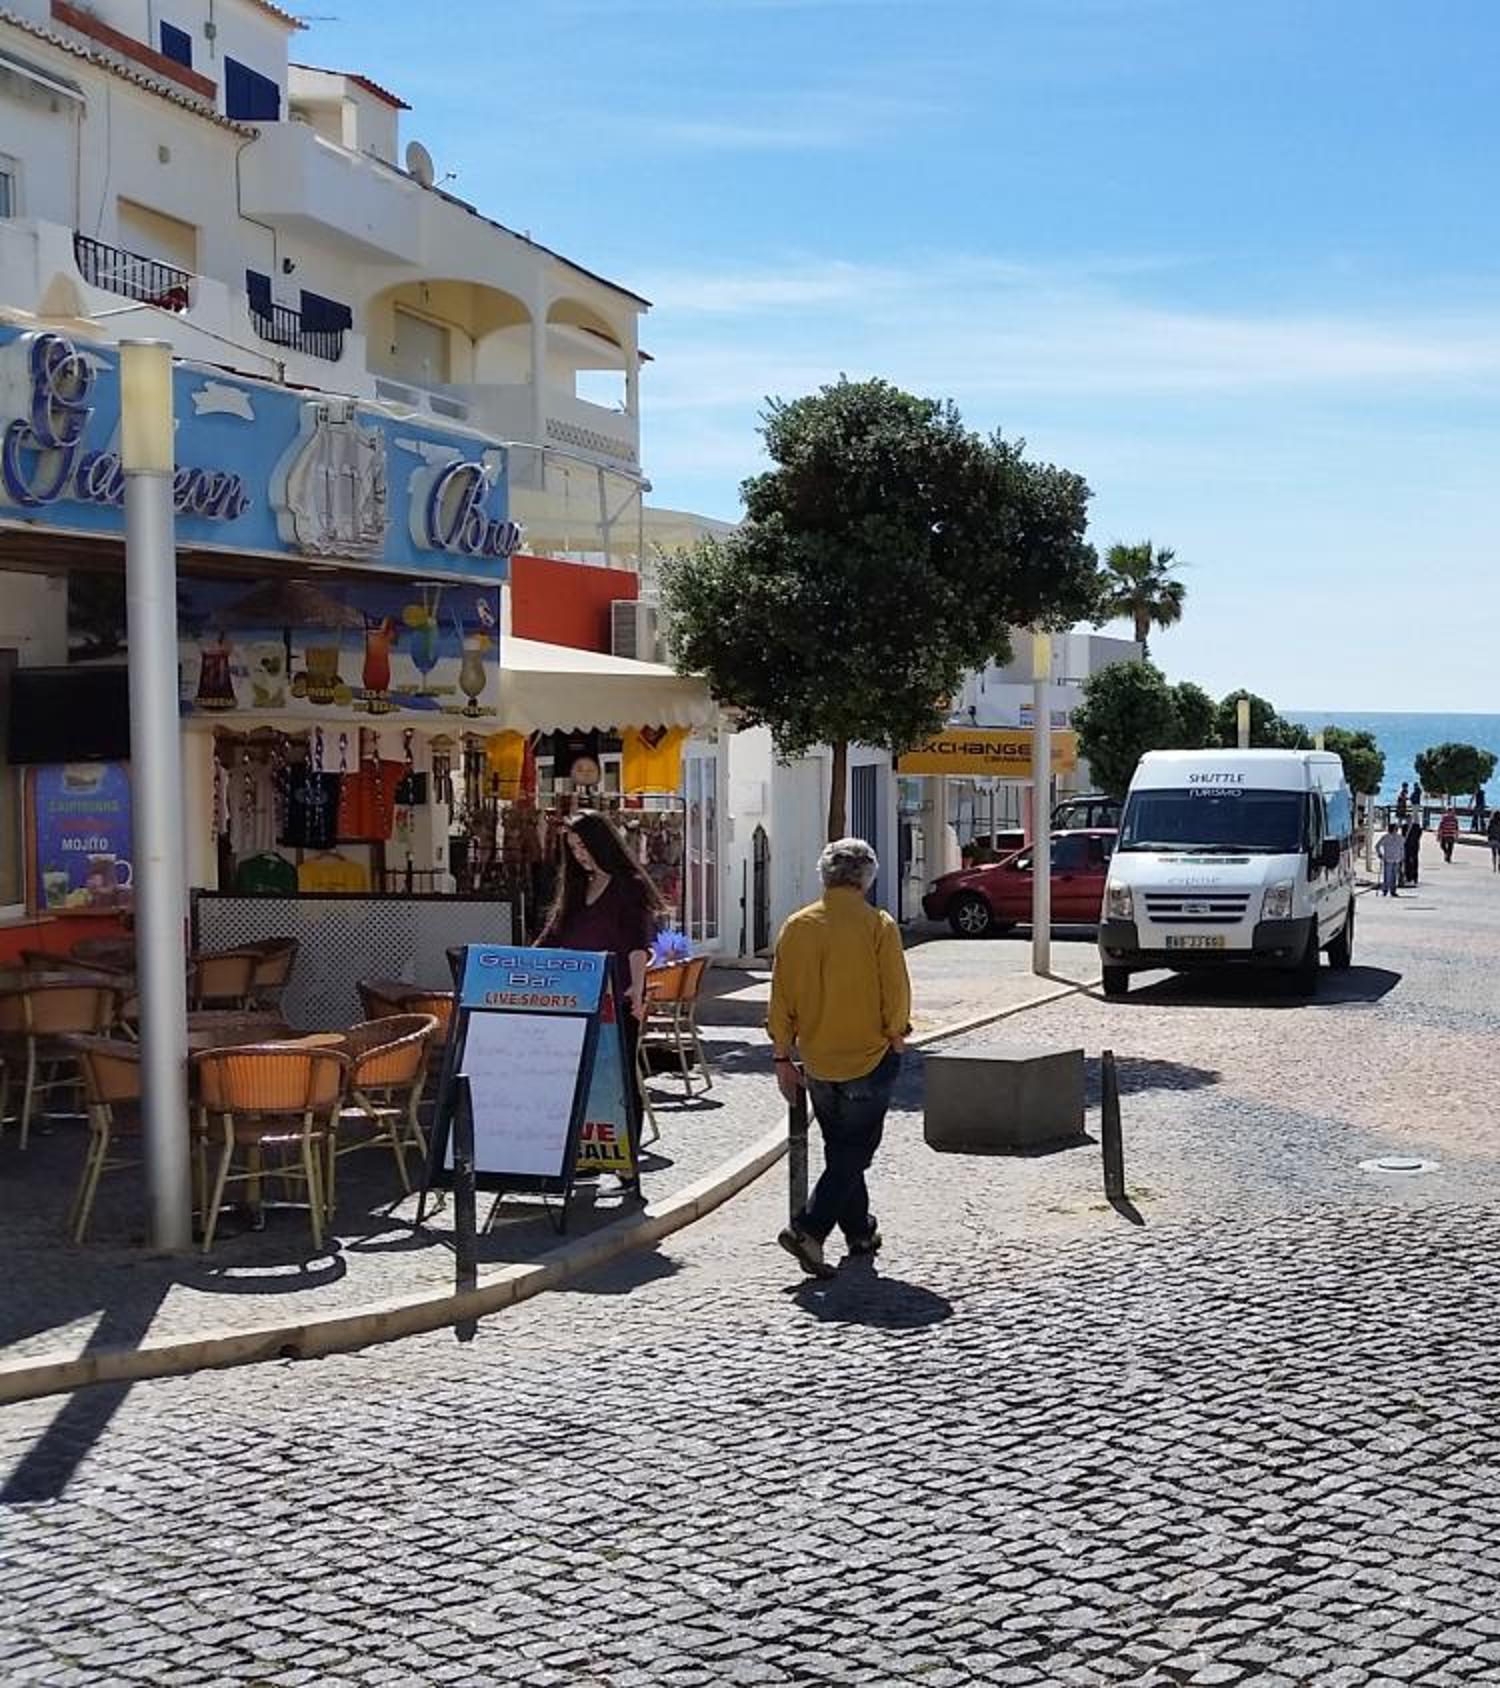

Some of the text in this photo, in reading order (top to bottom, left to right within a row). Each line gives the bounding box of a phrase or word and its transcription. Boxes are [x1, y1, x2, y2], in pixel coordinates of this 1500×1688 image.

[1188, 773, 1245, 783] SHUTTLE
[1188, 788, 1243, 798] TURISMO
[61, 836, 109, 850] MOJITO
[509, 972, 561, 988] Bar
